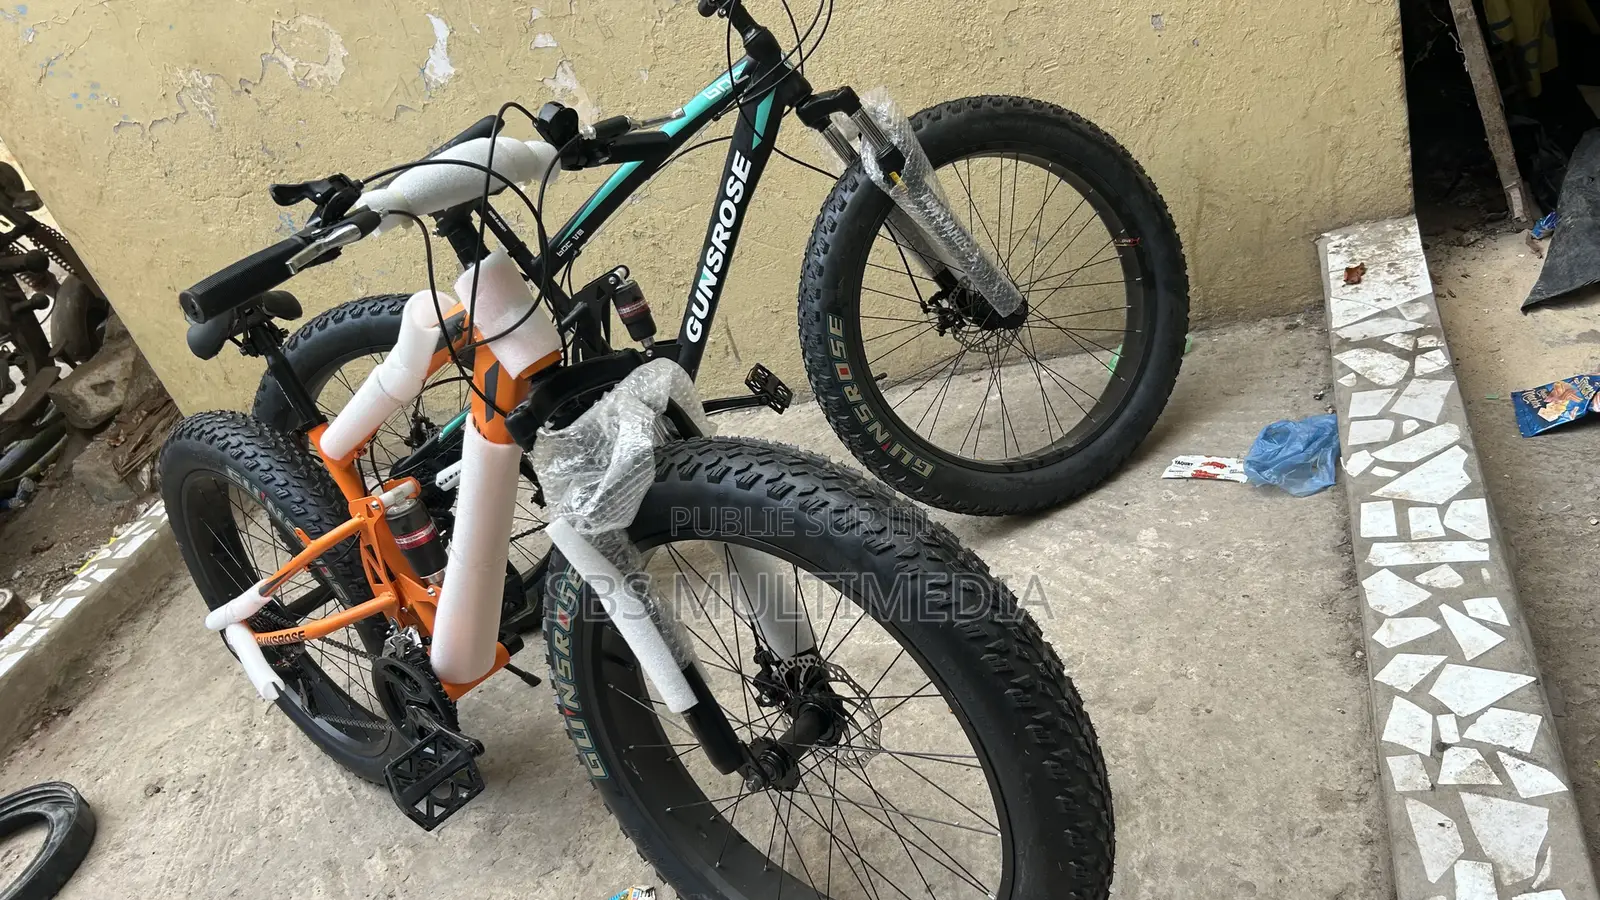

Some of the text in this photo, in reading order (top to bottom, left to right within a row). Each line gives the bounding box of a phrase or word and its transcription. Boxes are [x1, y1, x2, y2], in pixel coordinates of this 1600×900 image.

[686, 150, 752, 343] GUNSROSE
[826, 313, 936, 480] GUNSROSE
[553, 563, 610, 780] GUNSROSE
